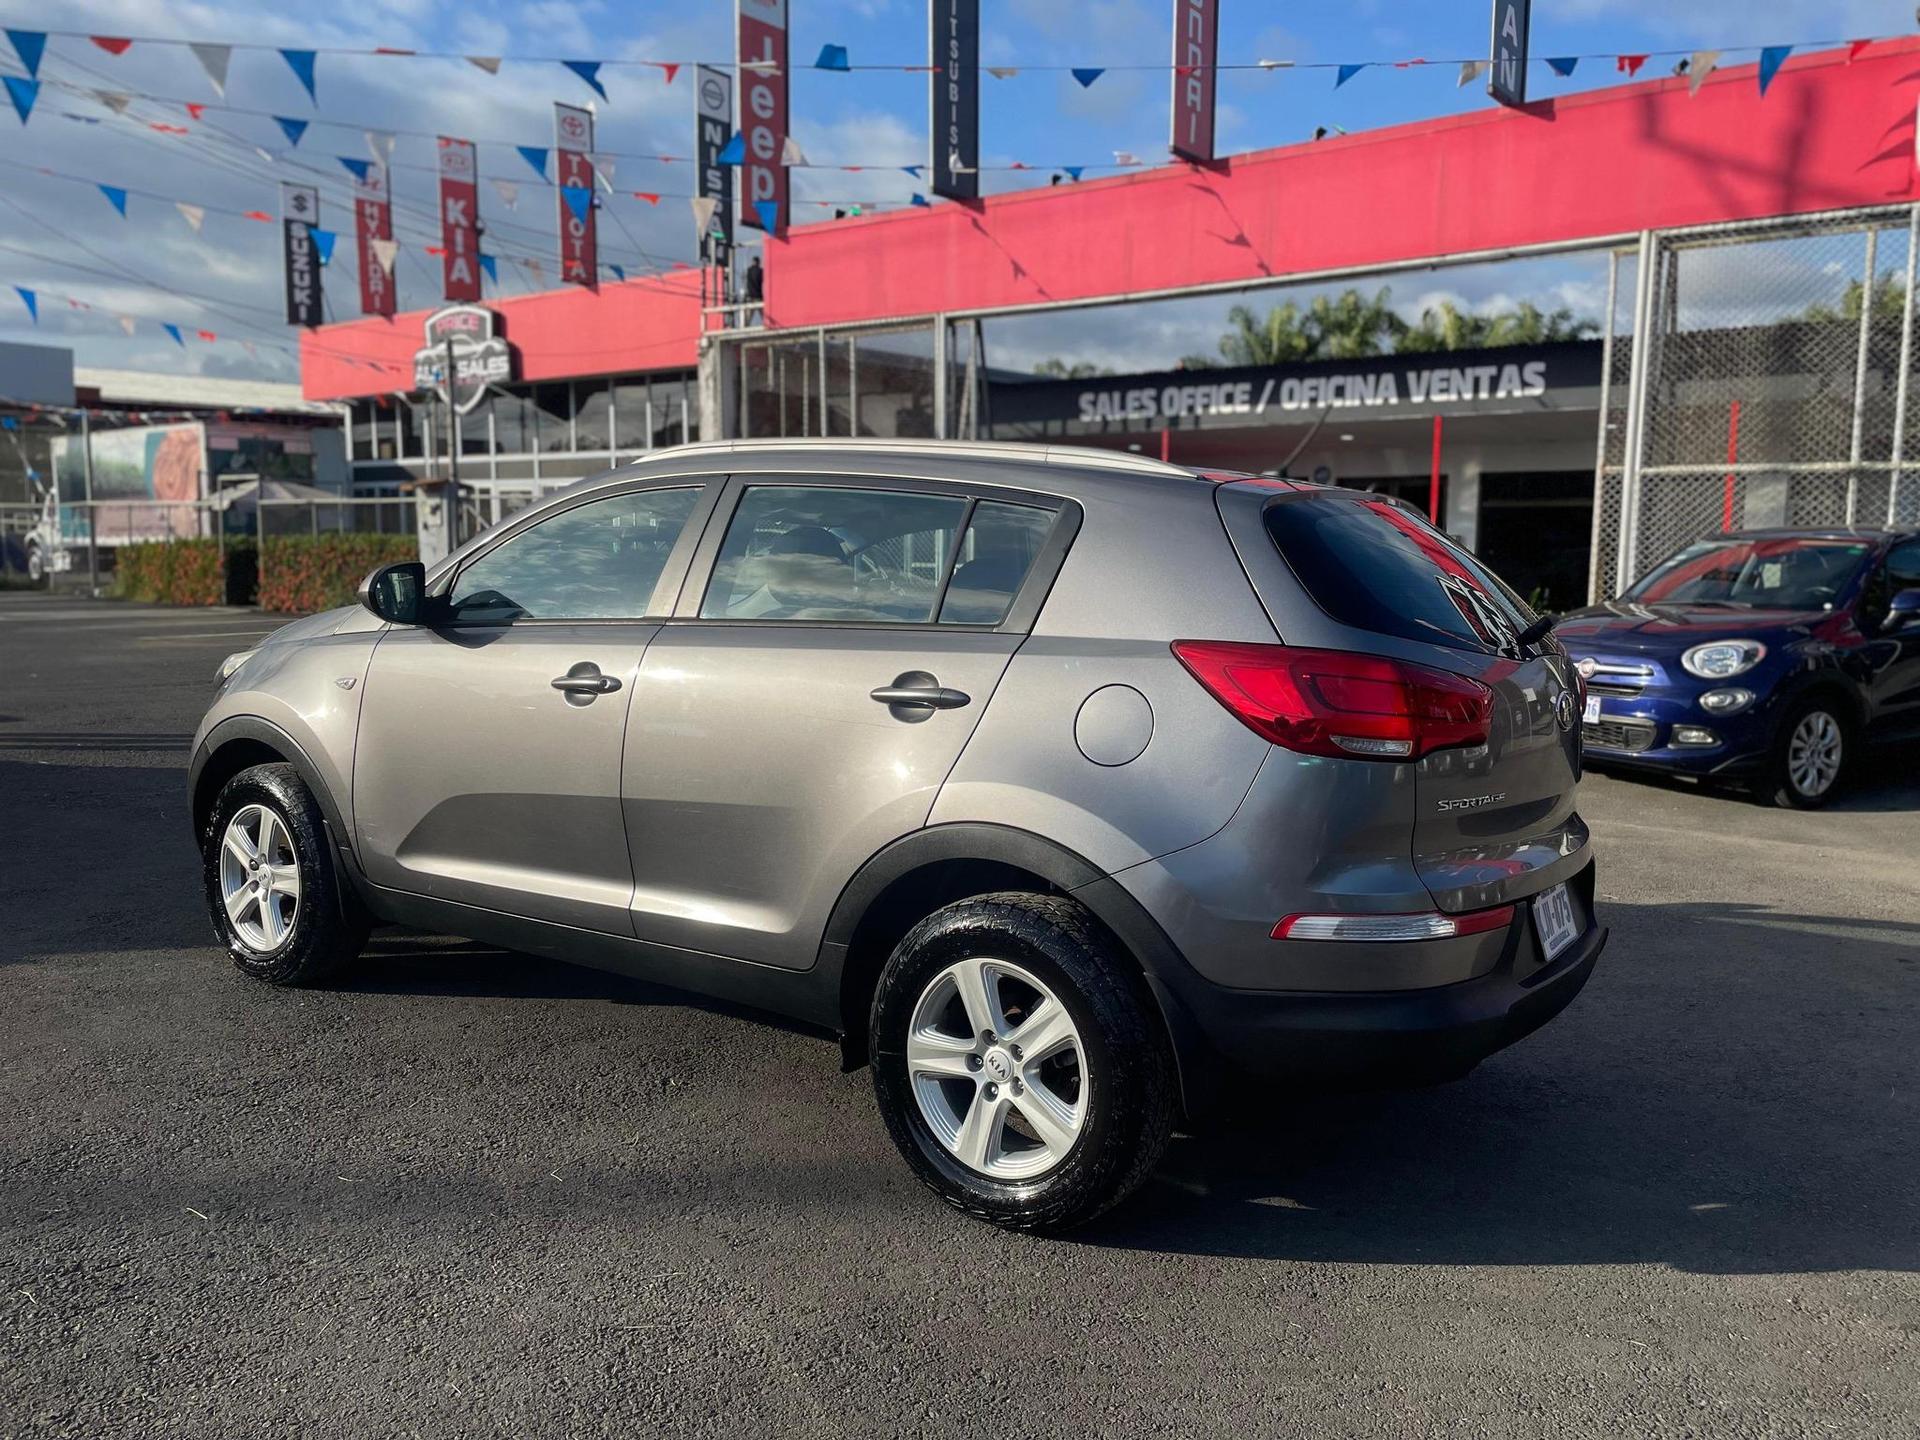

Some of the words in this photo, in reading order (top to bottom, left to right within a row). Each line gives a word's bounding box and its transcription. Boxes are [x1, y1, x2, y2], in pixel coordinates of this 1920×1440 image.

[1187, 0, 1203, 144] NDAI
[1501, 4, 1518, 92] AN
[751, 36, 776, 203] Jeep
[446, 197, 472, 284] KIA
[567, 154, 586, 278] TOOTA
[290, 221, 311, 321] SUZUKI
[457, 355, 509, 379] SALES
[1078, 387, 1157, 422] SALES
[1161, 382, 1252, 417] OFFICE
[1255, 379, 1275, 414] /
[1280, 372, 1399, 410] OFICINA
[1406, 361, 1547, 404] VENTAS
[989, 1055, 1006, 1077] KIA
